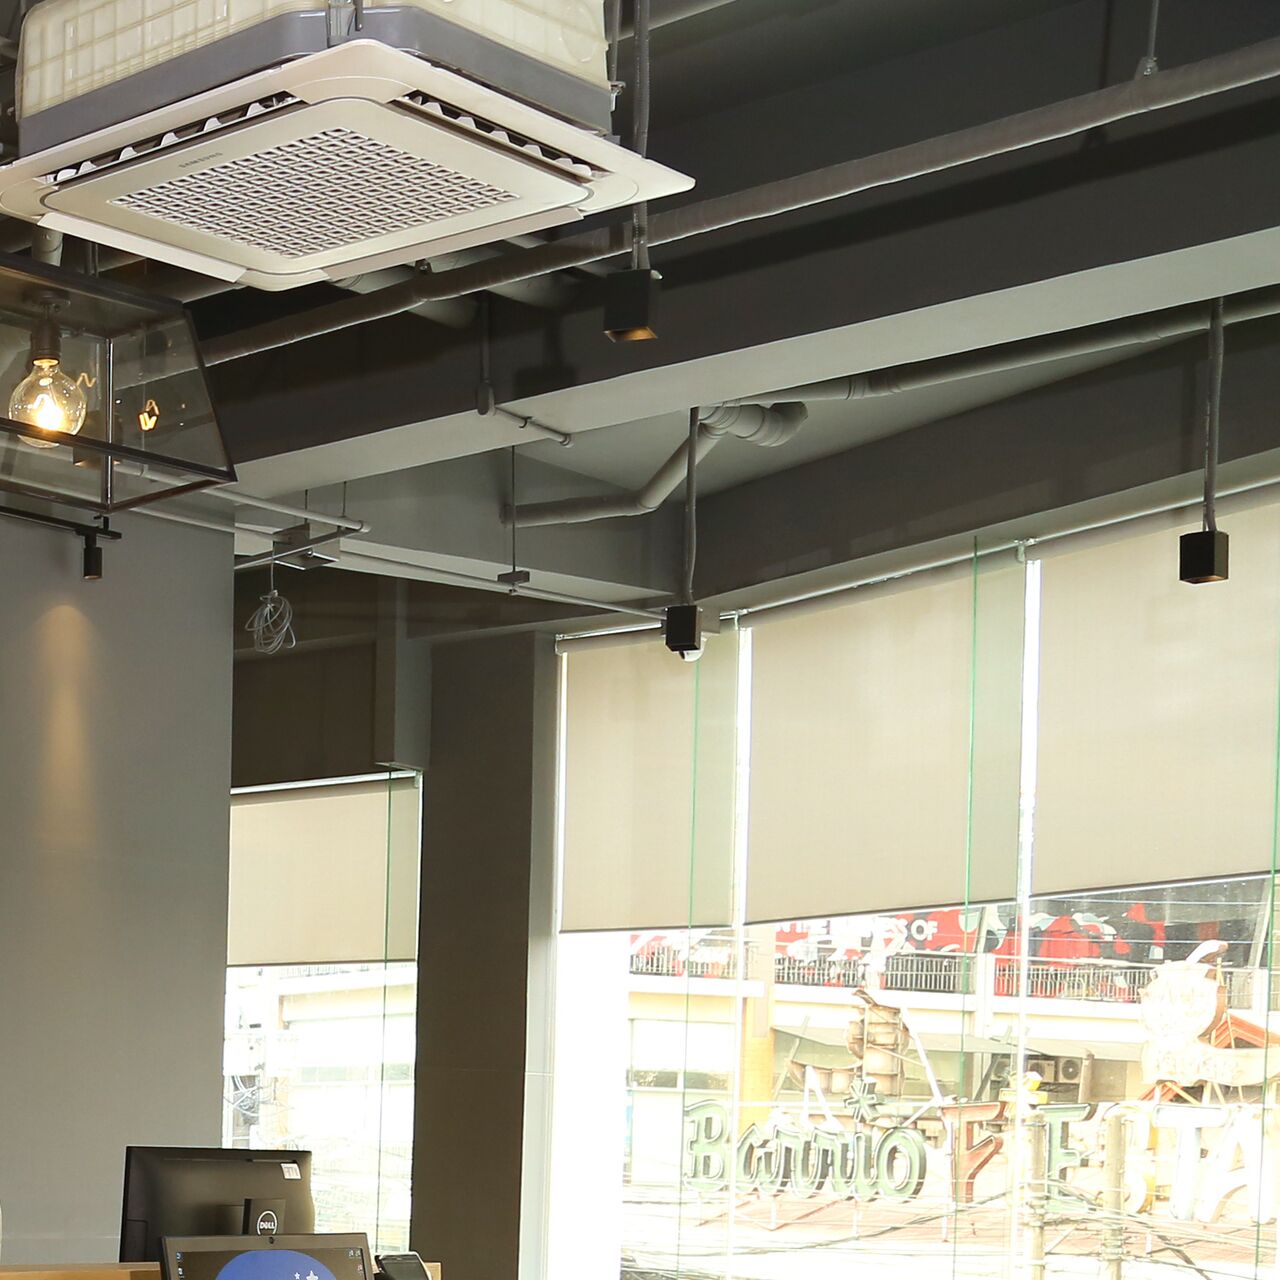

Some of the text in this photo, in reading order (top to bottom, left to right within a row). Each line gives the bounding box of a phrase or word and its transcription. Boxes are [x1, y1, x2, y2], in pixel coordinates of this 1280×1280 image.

[910, 918, 939, 942] OF
[683, 1078, 927, 1202] Barrio
[259, 1220, 276, 1230] DELL
